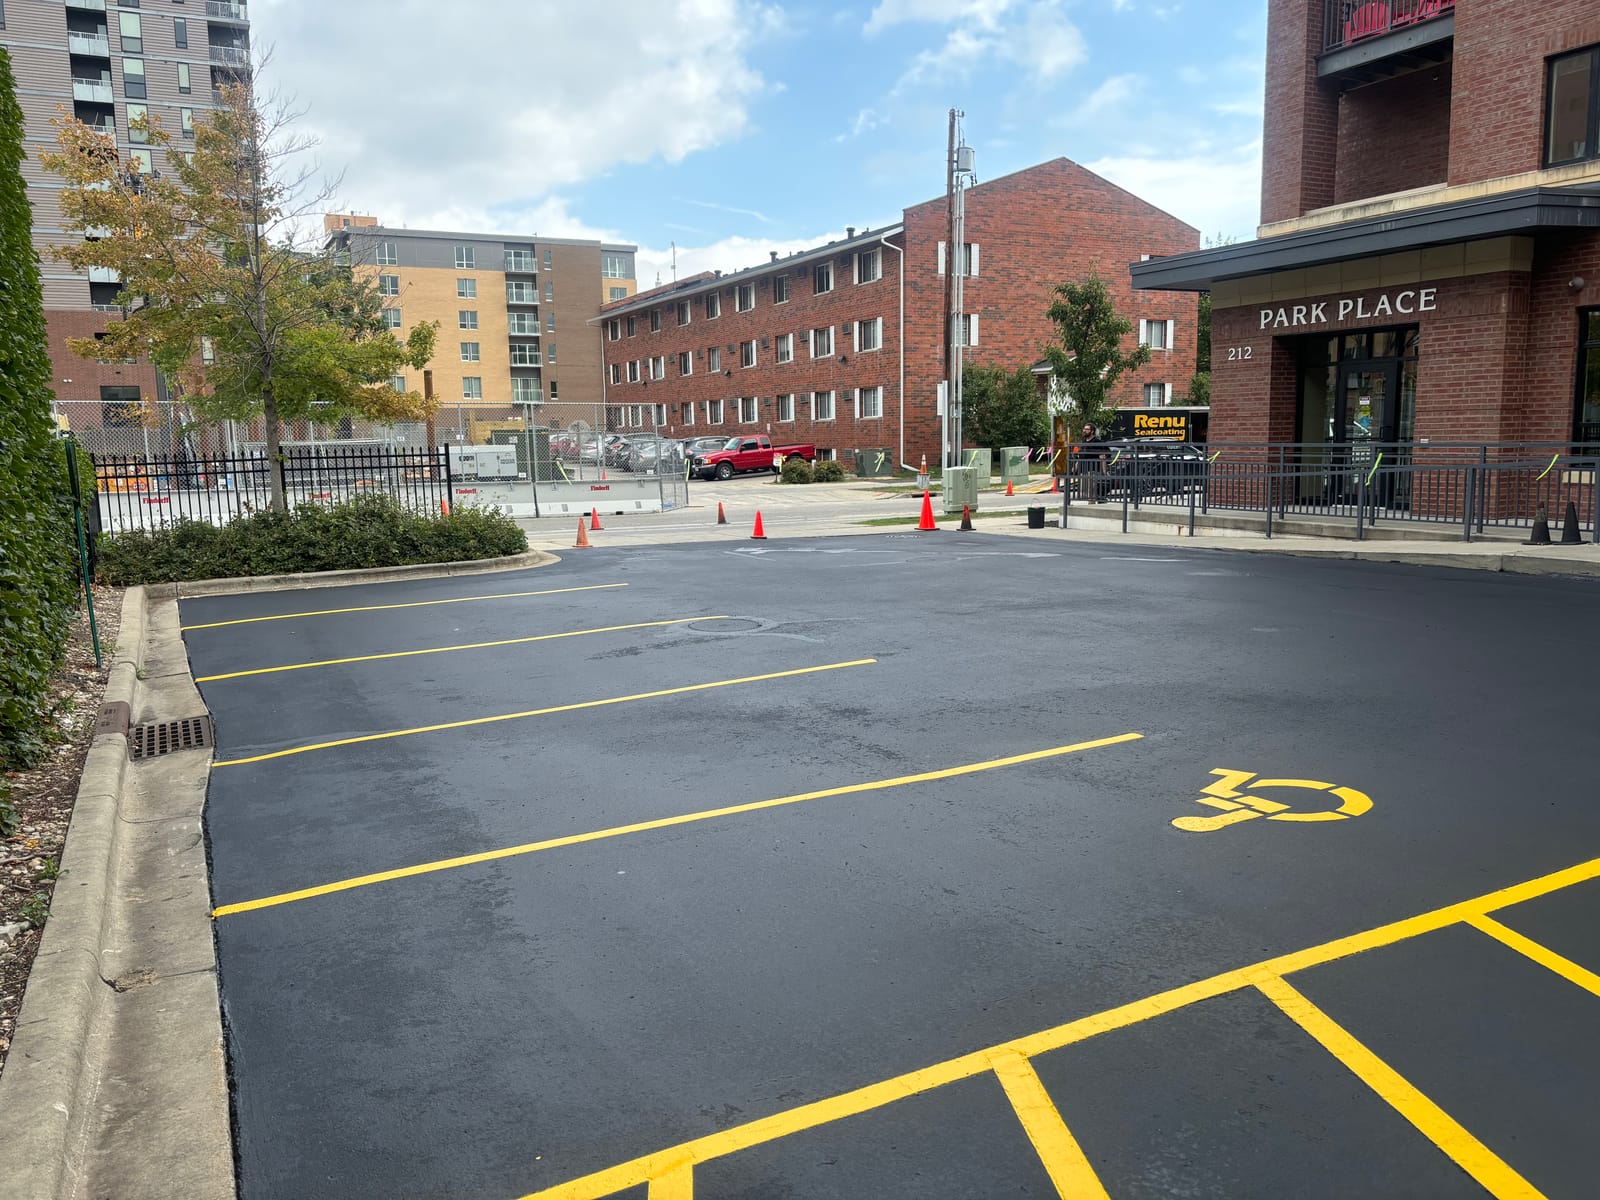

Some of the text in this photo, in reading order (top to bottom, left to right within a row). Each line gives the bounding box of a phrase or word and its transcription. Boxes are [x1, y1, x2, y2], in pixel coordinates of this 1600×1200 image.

[1259, 288, 1438, 330] PARK PLACE
[1228, 346, 1252, 361] 212
[1134, 414, 1186, 428] Renu
[1134, 429, 1186, 441] Sealcoating
